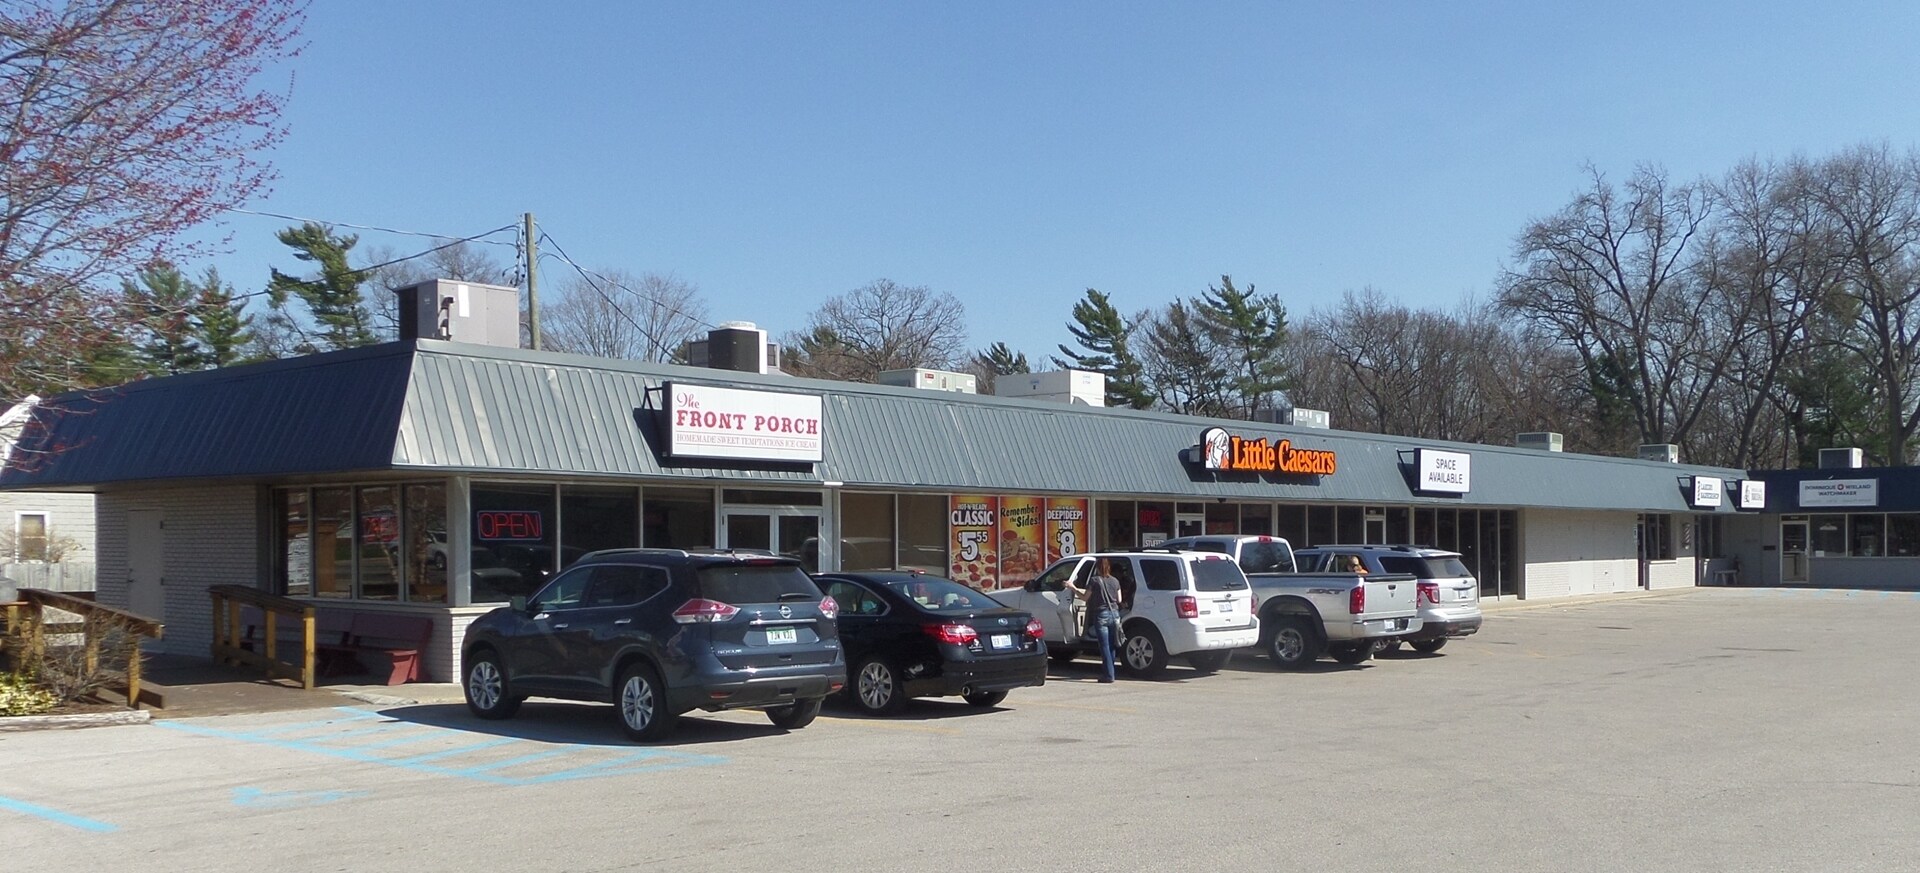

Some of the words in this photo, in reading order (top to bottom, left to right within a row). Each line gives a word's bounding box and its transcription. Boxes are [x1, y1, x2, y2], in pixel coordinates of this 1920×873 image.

[676, 392, 700, 409] The
[676, 410, 747, 430] FRONT
[754, 415, 819, 435] PORCH
[676, 433, 717, 443] HOMEMADE
[717, 436, 740, 445] SWEET
[741, 437, 784, 447] TEMPTATIONS
[796, 441, 818, 449] CREAM
[1231, 437, 1275, 470] Little
[1278, 439, 1335, 474] Caesars
[1435, 458, 1456, 470] SPACE
[1428, 471, 1463, 484] AVAILABLE
[951, 510, 994, 526] CLASSIC
[1000, 504, 1039, 518] Remember
[480, 512, 540, 538] OPEN
[1016, 514, 1042, 528] Sides!
[1058, 520, 1073, 530] DISH
